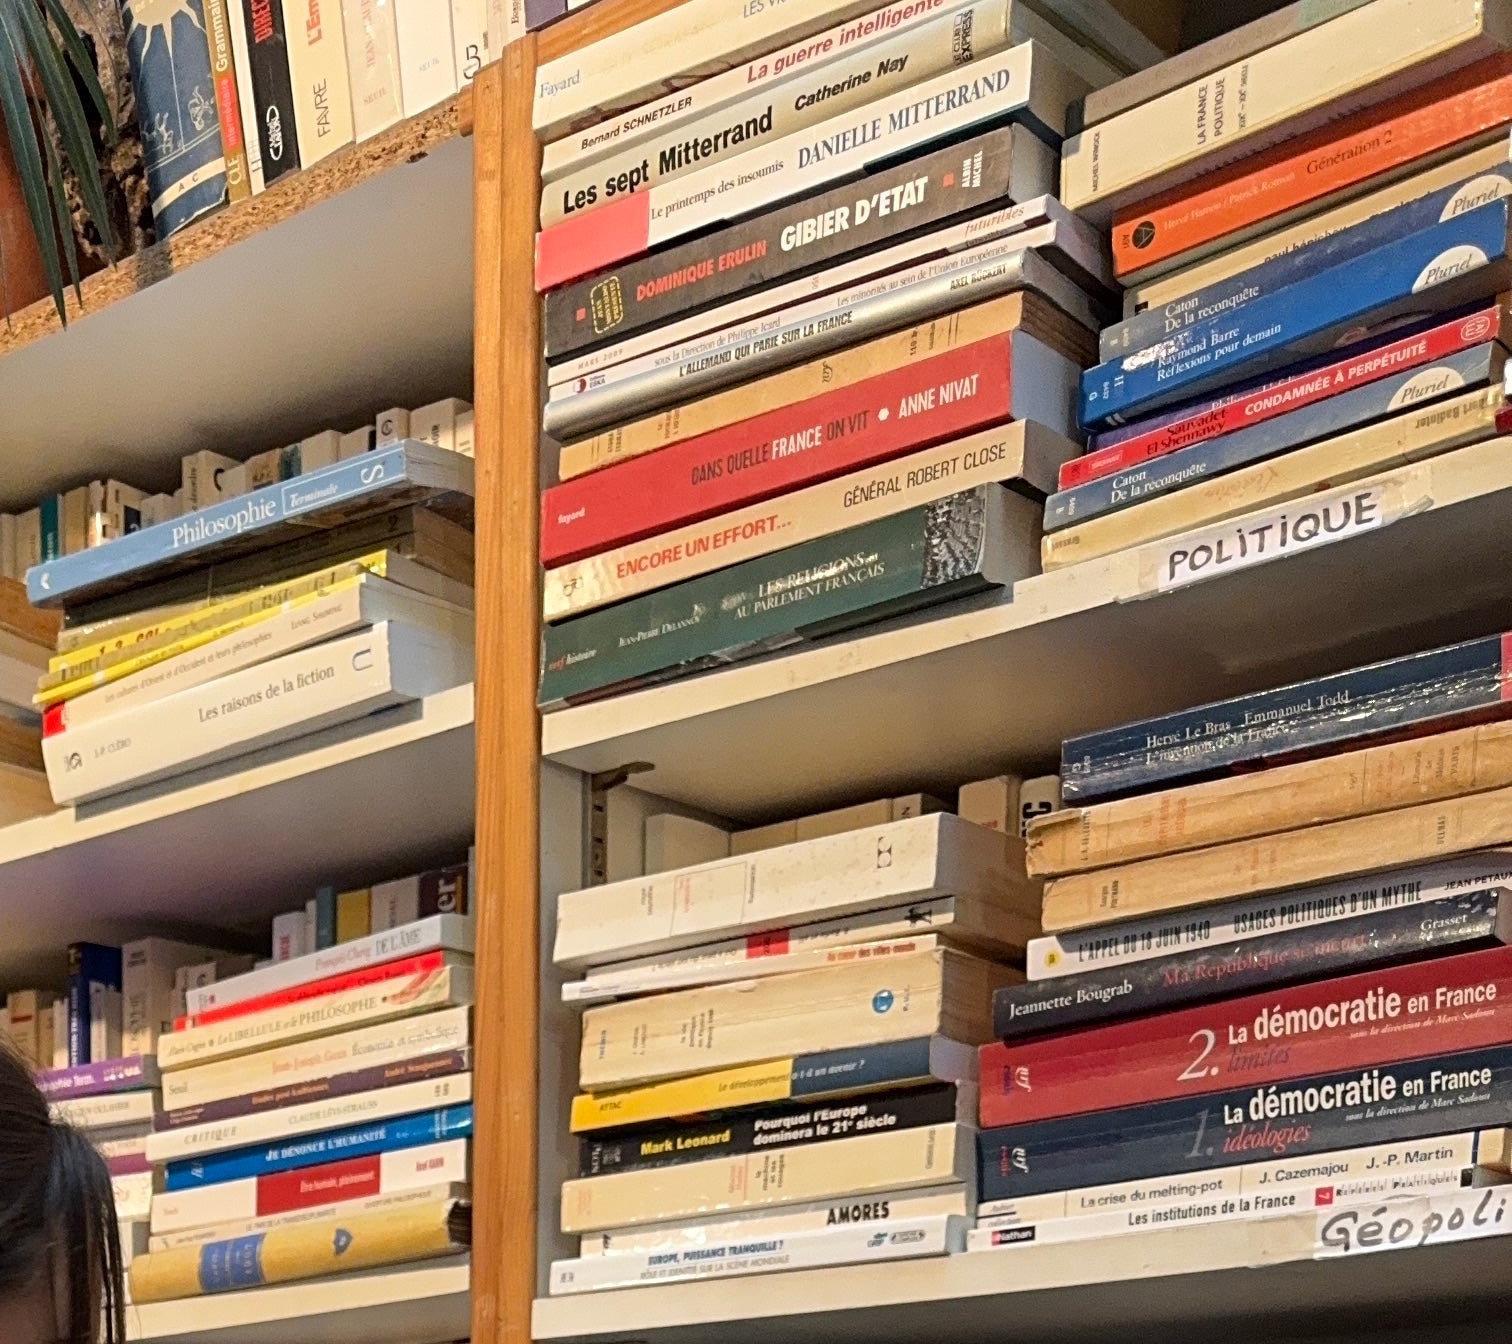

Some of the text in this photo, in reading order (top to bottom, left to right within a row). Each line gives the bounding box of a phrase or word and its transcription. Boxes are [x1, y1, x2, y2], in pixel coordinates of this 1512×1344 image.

[747, 0, 944, 83] La guerre intelligente
[539, 70, 581, 99] Fayard
[795, 54, 908, 111] Catherine Nay
[1214, 78, 1225, 137] POLITIQUE
[317, 78, 328, 138] FAVRE
[582, 96, 692, 150] Bernard SCHNETZLER
[799, 69, 1011, 169] DANIELLE MITTERRAND
[1197, 84, 1207, 145] LA FRANCE
[564, 106, 773, 214] Les sept Mitterrand
[961, 151, 982, 188] ALBIN MICHEL
[1307, 130, 1392, 176] Génération 2
[781, 176, 929, 252] GIBIER D'ETAT
[1452, 184, 1500, 215] Pluriel
[636, 241, 767, 301] DOMINIQUE ERULIN
[1425, 255, 1473, 285] Pluriel
[899, 375, 980, 418] ANNE NIVAT
[1245, 341, 1426, 416] CONDAMNÉE À PERPÉTUITÉ
[1399, 375, 1449, 403] Pluriel
[691, 412, 869, 485] DANS QUELLE FRANCE ON VIT
[844, 442, 1006, 508] GÉNÉRAL ROBERT CLOSE
[172, 484, 338, 547] Philosophie Terminale
[617, 546, 682, 579] ENCORE
[686, 536, 708, 558] UN
[198, 665, 335, 722] Les raisons de la fiction
[299, 996, 377, 1026] PHILOSOPHE
[1009, 980, 1133, 1019] Jeannette Bougrab
[1228, 980, 1497, 1045] La démocratie en France
[754, 1104, 867, 1130] Pourquoi l'Europe
[1224, 1066, 1492, 1124] La démocratie en France
[185, 1126, 237, 1144] CRITIQUE
[641, 1130, 730, 1156] Mark Leonard
[754, 1128, 813, 1145] dominera
[816, 1124, 829, 1138] le
[856, 1113, 895, 1130] siècle
[1223, 1123, 1311, 1155] idéologies
[826, 1202, 889, 1225] AMORES
[1128, 1193, 1295, 1226] Les institutions de la France
